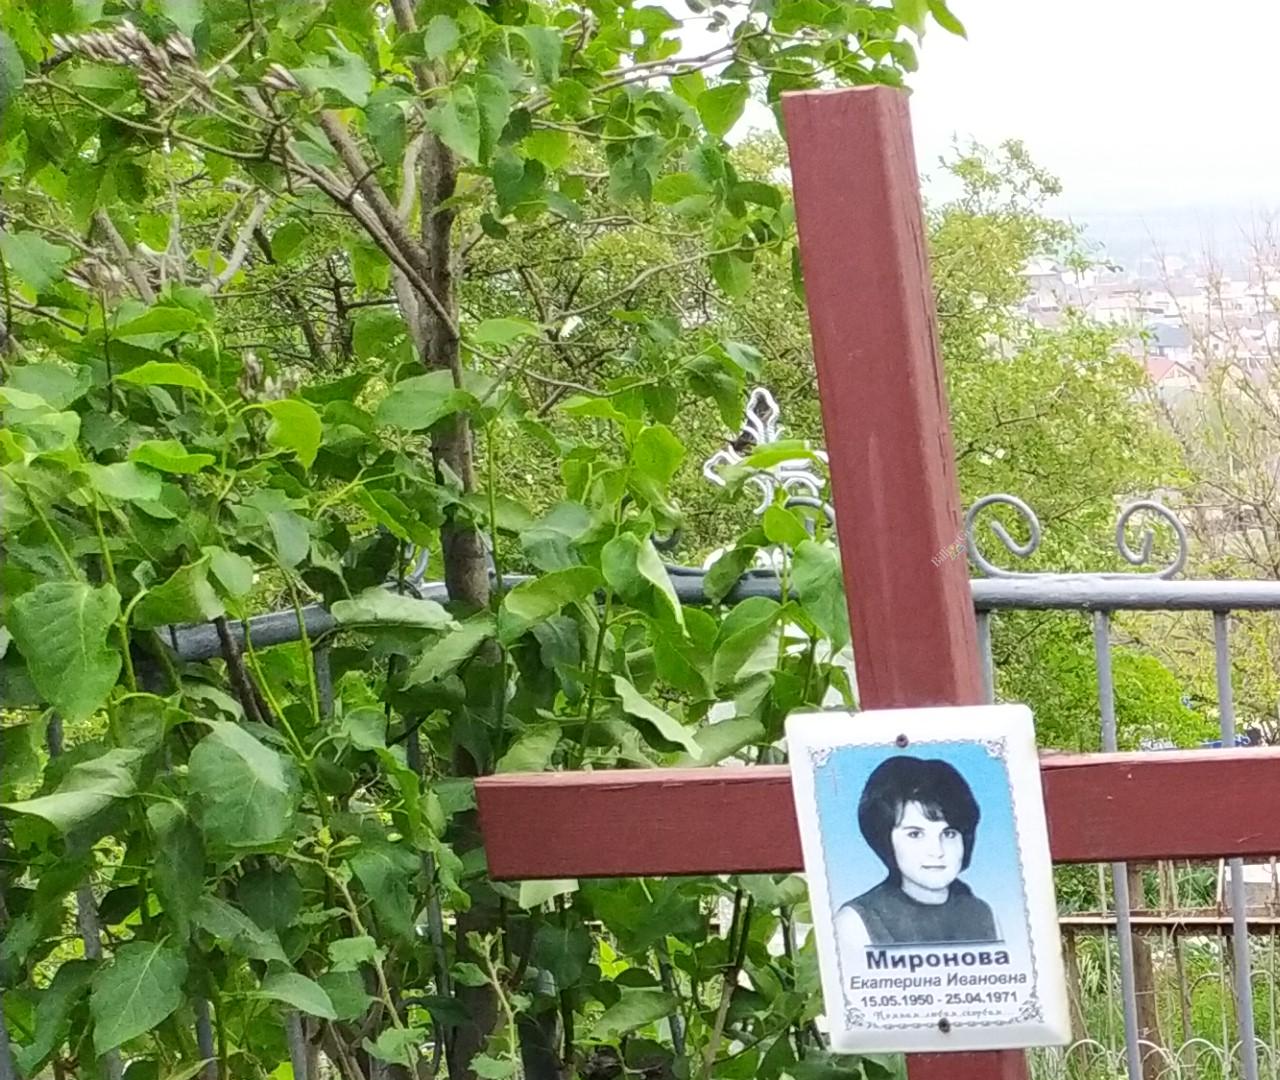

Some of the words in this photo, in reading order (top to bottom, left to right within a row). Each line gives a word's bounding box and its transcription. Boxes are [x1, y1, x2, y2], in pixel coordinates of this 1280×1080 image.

[866, 950, 1010, 973] Миронова
[850, 975, 942, 991] Екатерина
[946, 972, 1027, 987] Ивановна
[861, 994, 934, 1008] 15.05.1950
[945, 991, 1018, 1006] 25.04.1971
